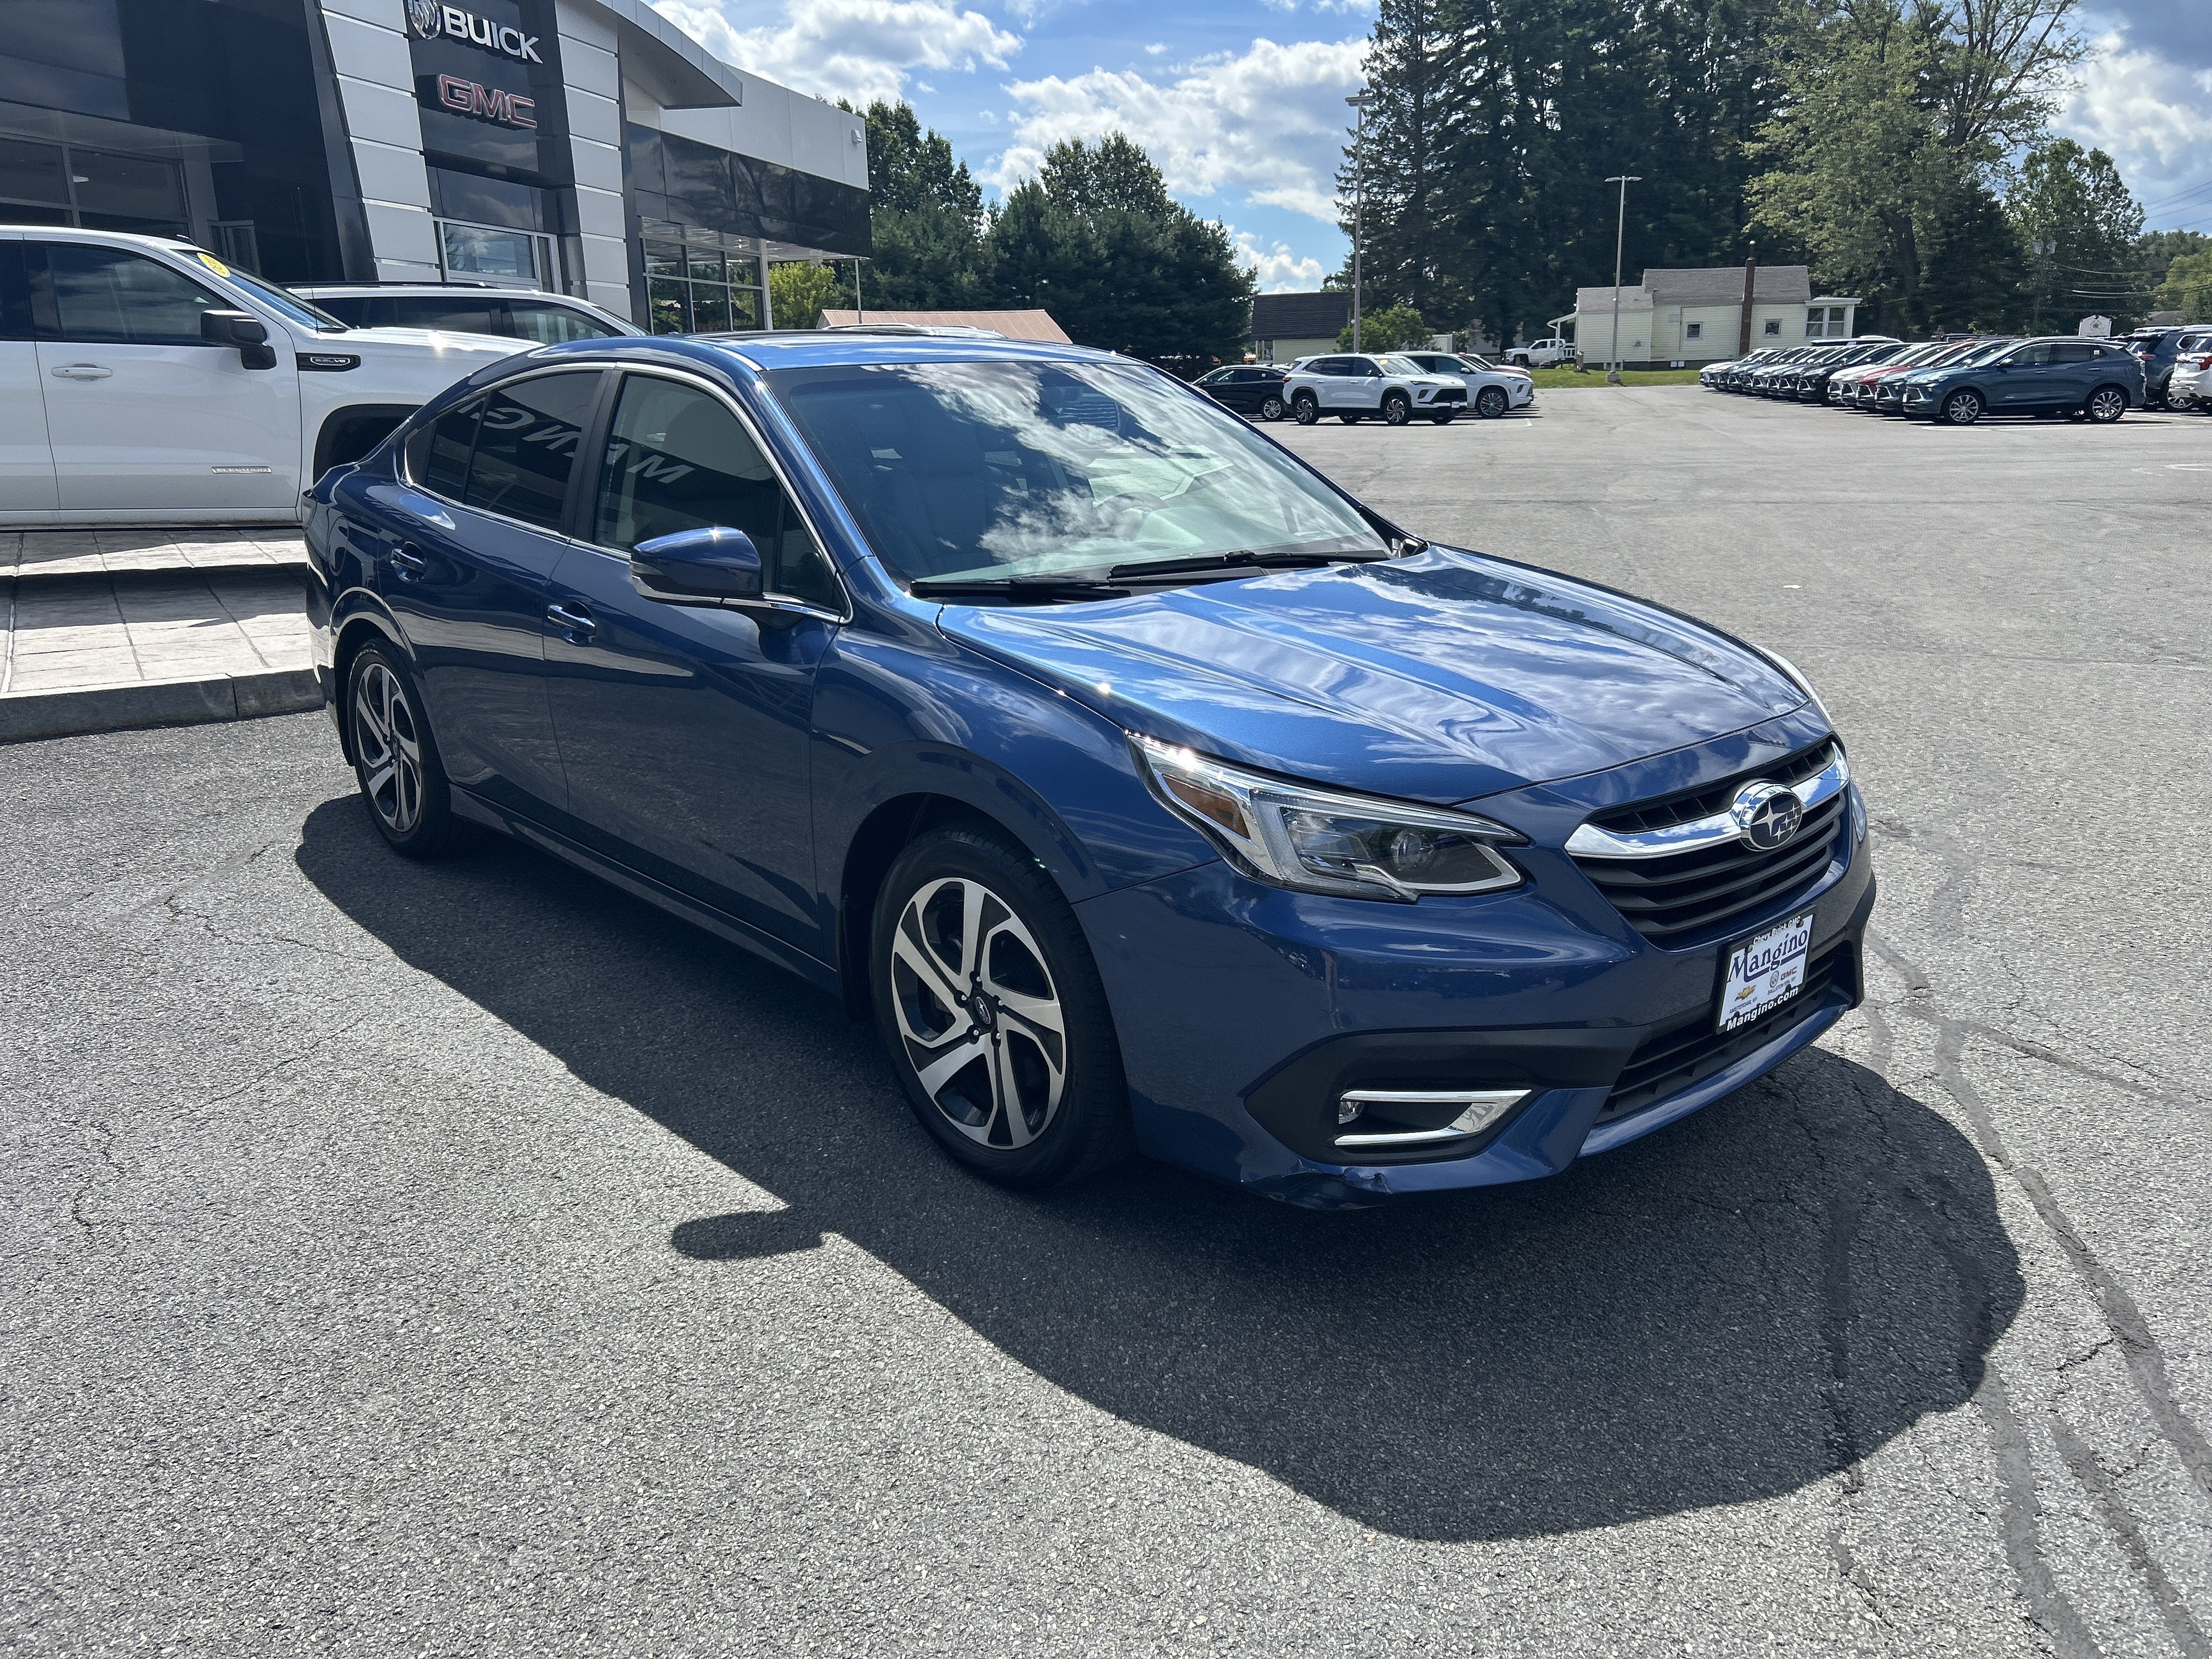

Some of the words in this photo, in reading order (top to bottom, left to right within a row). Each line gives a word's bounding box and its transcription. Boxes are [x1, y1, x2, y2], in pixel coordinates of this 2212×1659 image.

[442, 5, 543, 64] BUICK
[438, 74, 538, 129] GMC
[1753, 932, 1771, 944] Chevy
[1771, 923, 1787, 936] Buick
[1788, 916, 1801, 928] GMC
[1727, 929, 1808, 983] Mangino
[1780, 967, 1797, 980] GMC
[1726, 987, 1798, 1031] Mangino.com
